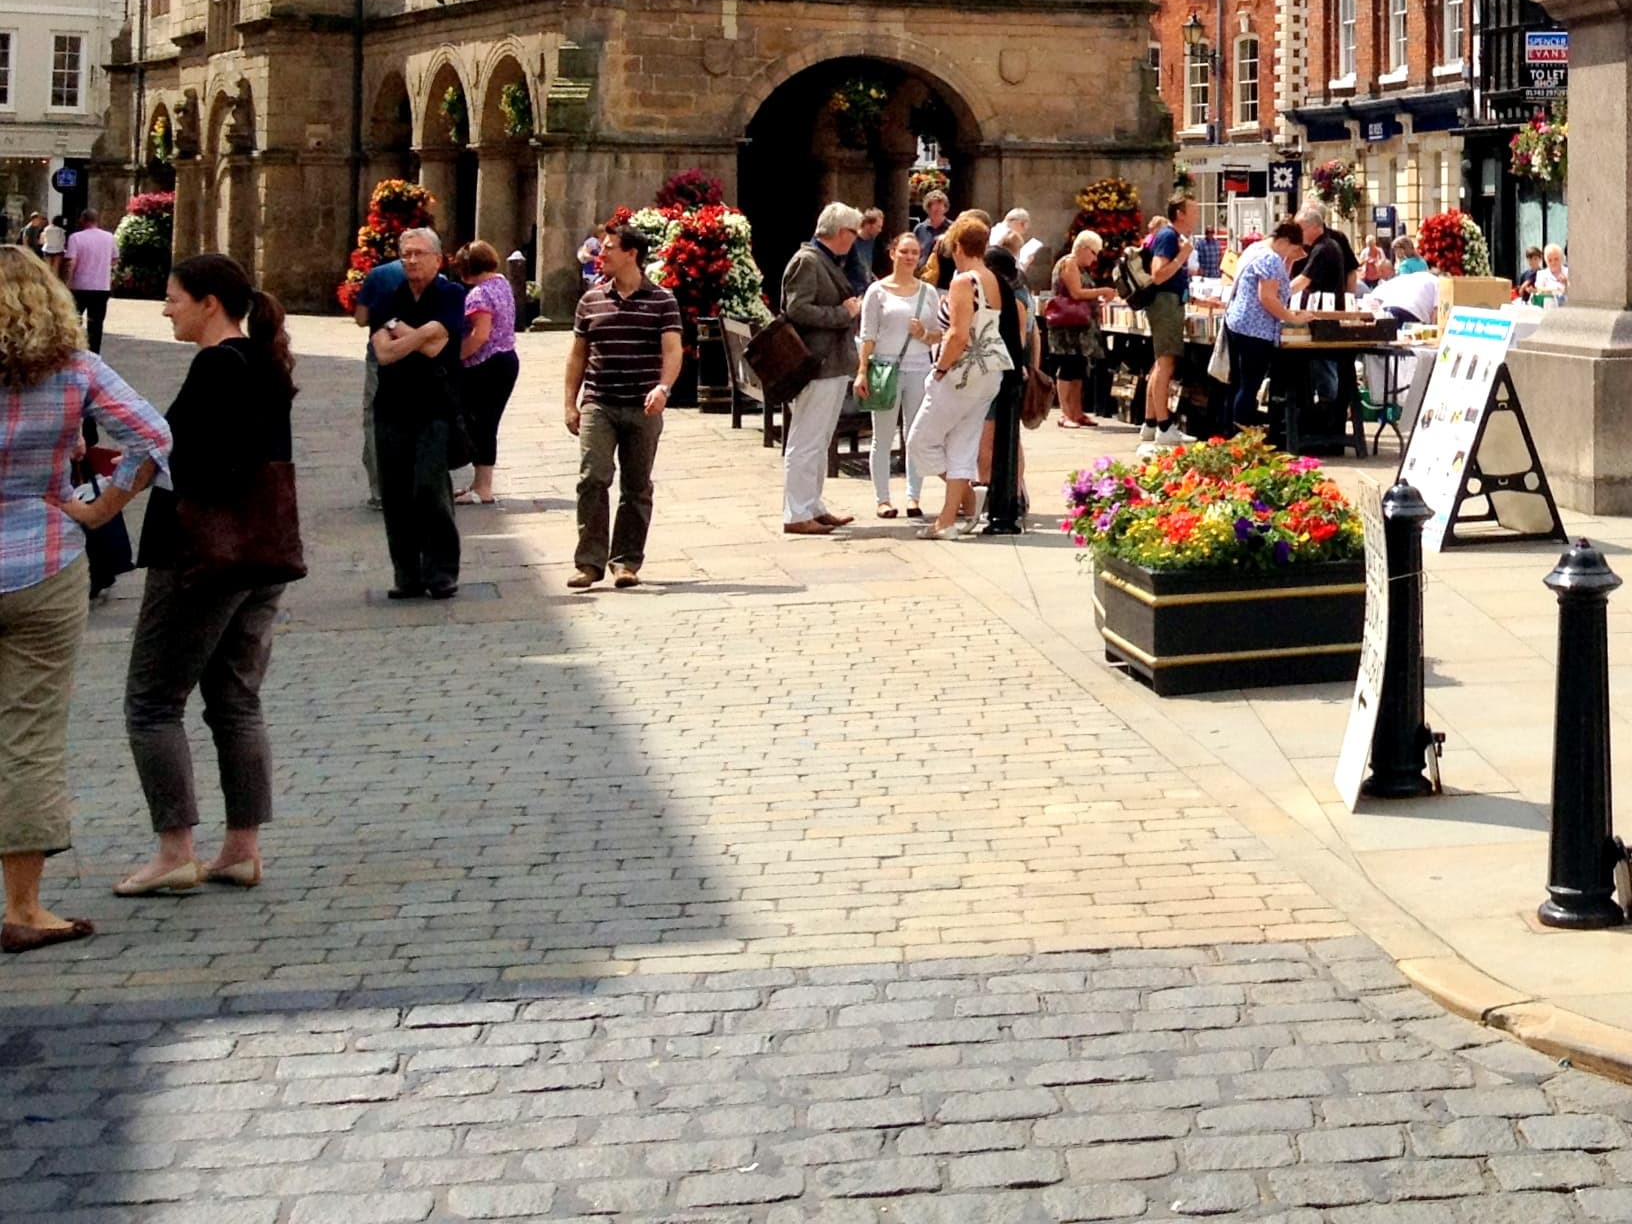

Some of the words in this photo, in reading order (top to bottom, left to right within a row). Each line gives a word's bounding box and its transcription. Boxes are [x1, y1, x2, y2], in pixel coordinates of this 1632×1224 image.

[1528, 48, 1567, 59] EVANS
[1530, 69, 1545, 80] TO
[1547, 69, 1565, 80] LET
[1534, 79, 1559, 89] SHOP
